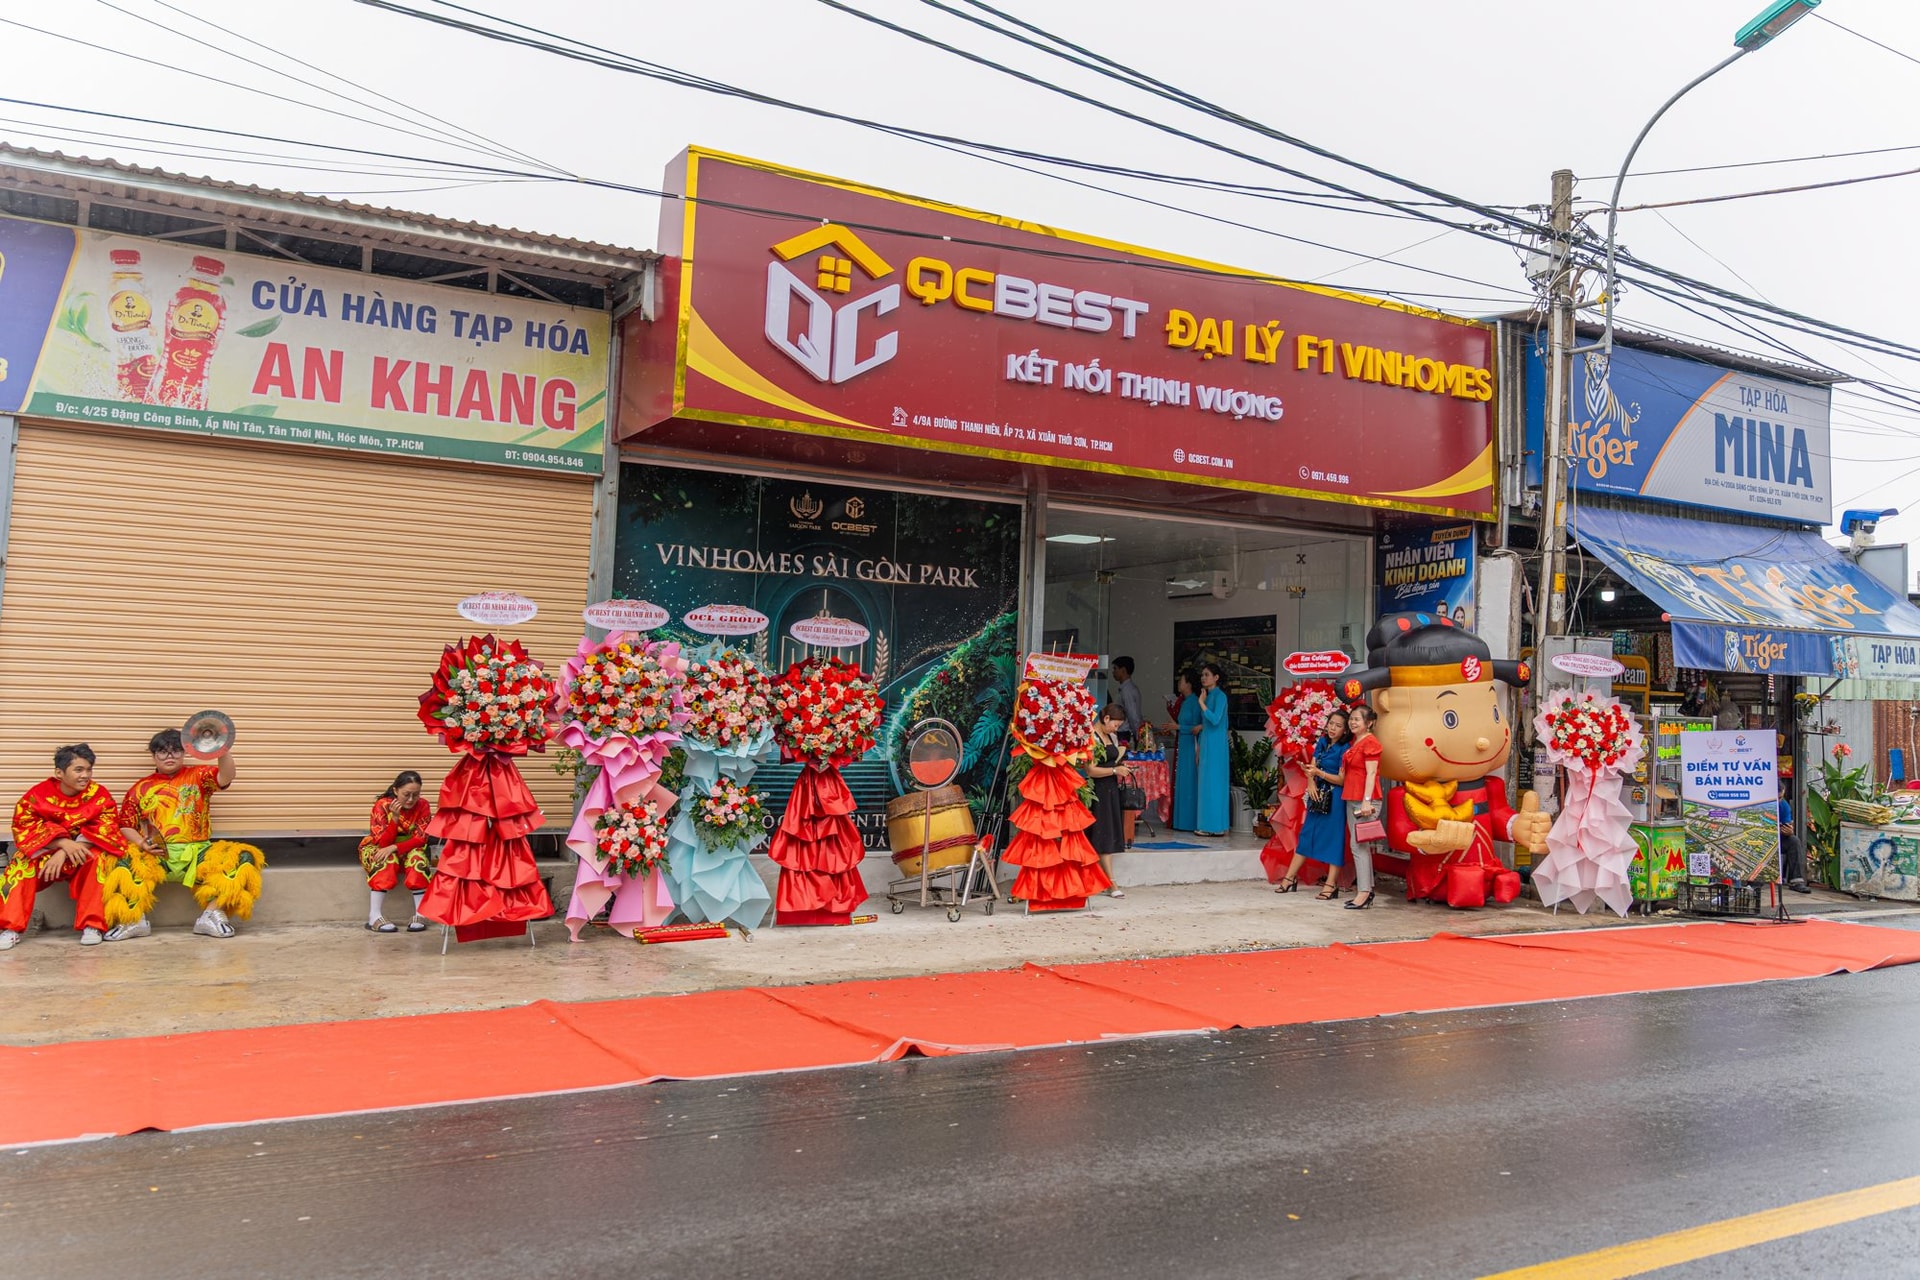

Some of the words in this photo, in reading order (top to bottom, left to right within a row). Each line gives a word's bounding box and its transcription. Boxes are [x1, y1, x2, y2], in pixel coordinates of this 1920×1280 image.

[252, 276, 327, 318] CỬA
[341, 291, 436, 334] HÀNG
[450, 310, 513, 347] TẠP
[524, 320, 589, 355] HÓA
[906, 256, 1149, 339] QCBEST
[1165, 308, 1233, 359] ĐẠI
[1244, 320, 1285, 364] LÝ
[1297, 334, 1334, 374] F1
[1340, 342, 1493, 401] VINHOMES
[251, 342, 344, 403] AN
[370, 355, 576, 431] KHANG
[1006, 349, 1058, 384] KẾT
[1064, 358, 1111, 394] NỐI
[1117, 371, 1190, 407] THỊNH
[1196, 384, 1284, 421] VƯỢNG
[1739, 387, 1761, 412] TẠP
[1765, 389, 1788, 414] HÓA
[56, 402, 79, 414] Đ/c:
[82, 405, 108, 417] 4/25
[111, 410, 140, 422] Đặng
[143, 412, 171, 426] Công
[205, 416, 219, 431] Ấp
[222, 420, 240, 432] Nhị
[243, 422, 265, 435] Tân,
[268, 425, 287, 436] Tân
[290, 427, 311, 438] Thới
[337, 431, 356, 443] Hóc
[359, 435, 383, 448] Môn,
[386, 438, 424, 450] TP.HCM
[912, 415, 931, 426] 4/9A
[933, 416, 957, 430] ĐƯỜNG
[960, 421, 983, 433] THANH
[985, 423, 1002, 437] NIÊN,
[1003, 423, 1013, 437] ẤP
[1015, 428, 1025, 440] 73,
[1026, 428, 1036, 441] XÃ
[1038, 430, 1056, 443] XUÂN
[1090, 439, 1113, 452] TP.HCM
[505, 450, 520, 460] ĐT:
[522, 452, 584, 467] 0904.954.846
[1188, 453, 1234, 469] QCBEST.COM.VN
[1568, 420, 1638, 478] Tiger
[1715, 413, 1813, 488] MINA
[831, 522, 878, 533] QCBEST
[655, 543, 804, 576] VINHOMES
[812, 552, 848, 578] SÀI
[856, 556, 912, 583] GÒN
[919, 565, 979, 588] PARK
[1384, 566, 1416, 586] KINH
[1418, 558, 1466, 581] DOANH
[1385, 546, 1421, 569] NHÂN
[1424, 541, 1455, 561] VIÊN
[1687, 564, 1884, 629] Tiger
[719, 615, 766, 624] GROUP
[1741, 633, 1788, 670] Tiger
[1871, 644, 1892, 669] TẠP
[1894, 642, 1916, 665] HÓA
[1686, 758, 1718, 771] ĐIỂM
[1722, 760, 1740, 771] TƯ
[1743, 757, 1771, 771] VẤN
[1695, 773, 1722, 785] BÁN
[1726, 773, 1763, 785] HÀNG
